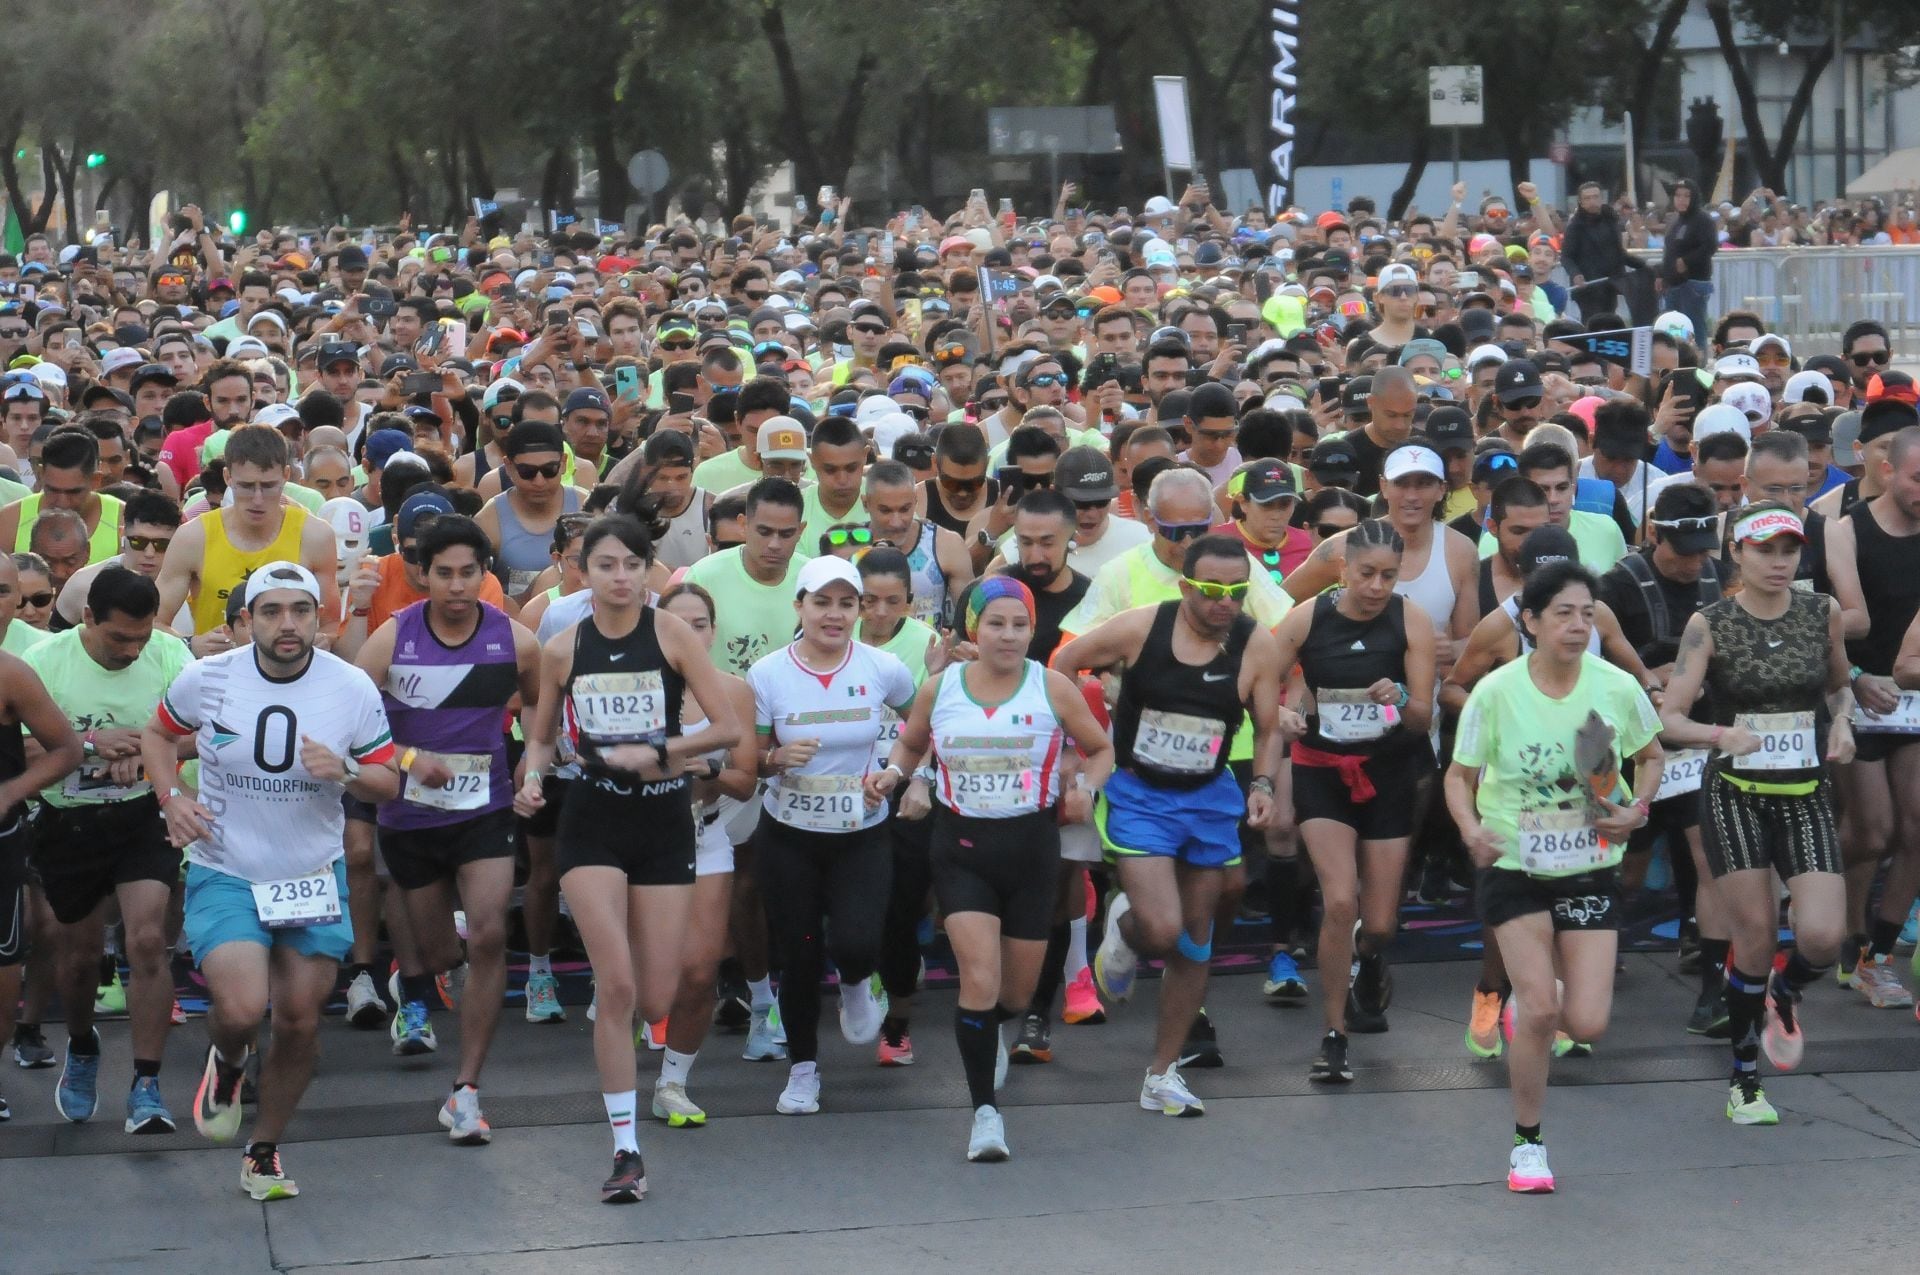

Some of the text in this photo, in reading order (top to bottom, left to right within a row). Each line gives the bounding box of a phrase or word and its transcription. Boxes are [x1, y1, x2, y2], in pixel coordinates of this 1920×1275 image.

[1269, 0, 1298, 217] GARMI
[991, 279, 1016, 291] 1:45
[1587, 338, 1629, 357] 1:55
[585, 694, 655, 715] 11823
[1341, 704, 1379, 721] 273
[1764, 733, 1804, 753] 060
[226, 772, 321, 793] OUTDOORFINS
[443, 775, 481, 793] 072
[958, 774, 1025, 793] 25374
[788, 792, 853, 813] 25210
[1530, 828, 1598, 854] 28668
[270, 878, 328, 903] 2382
